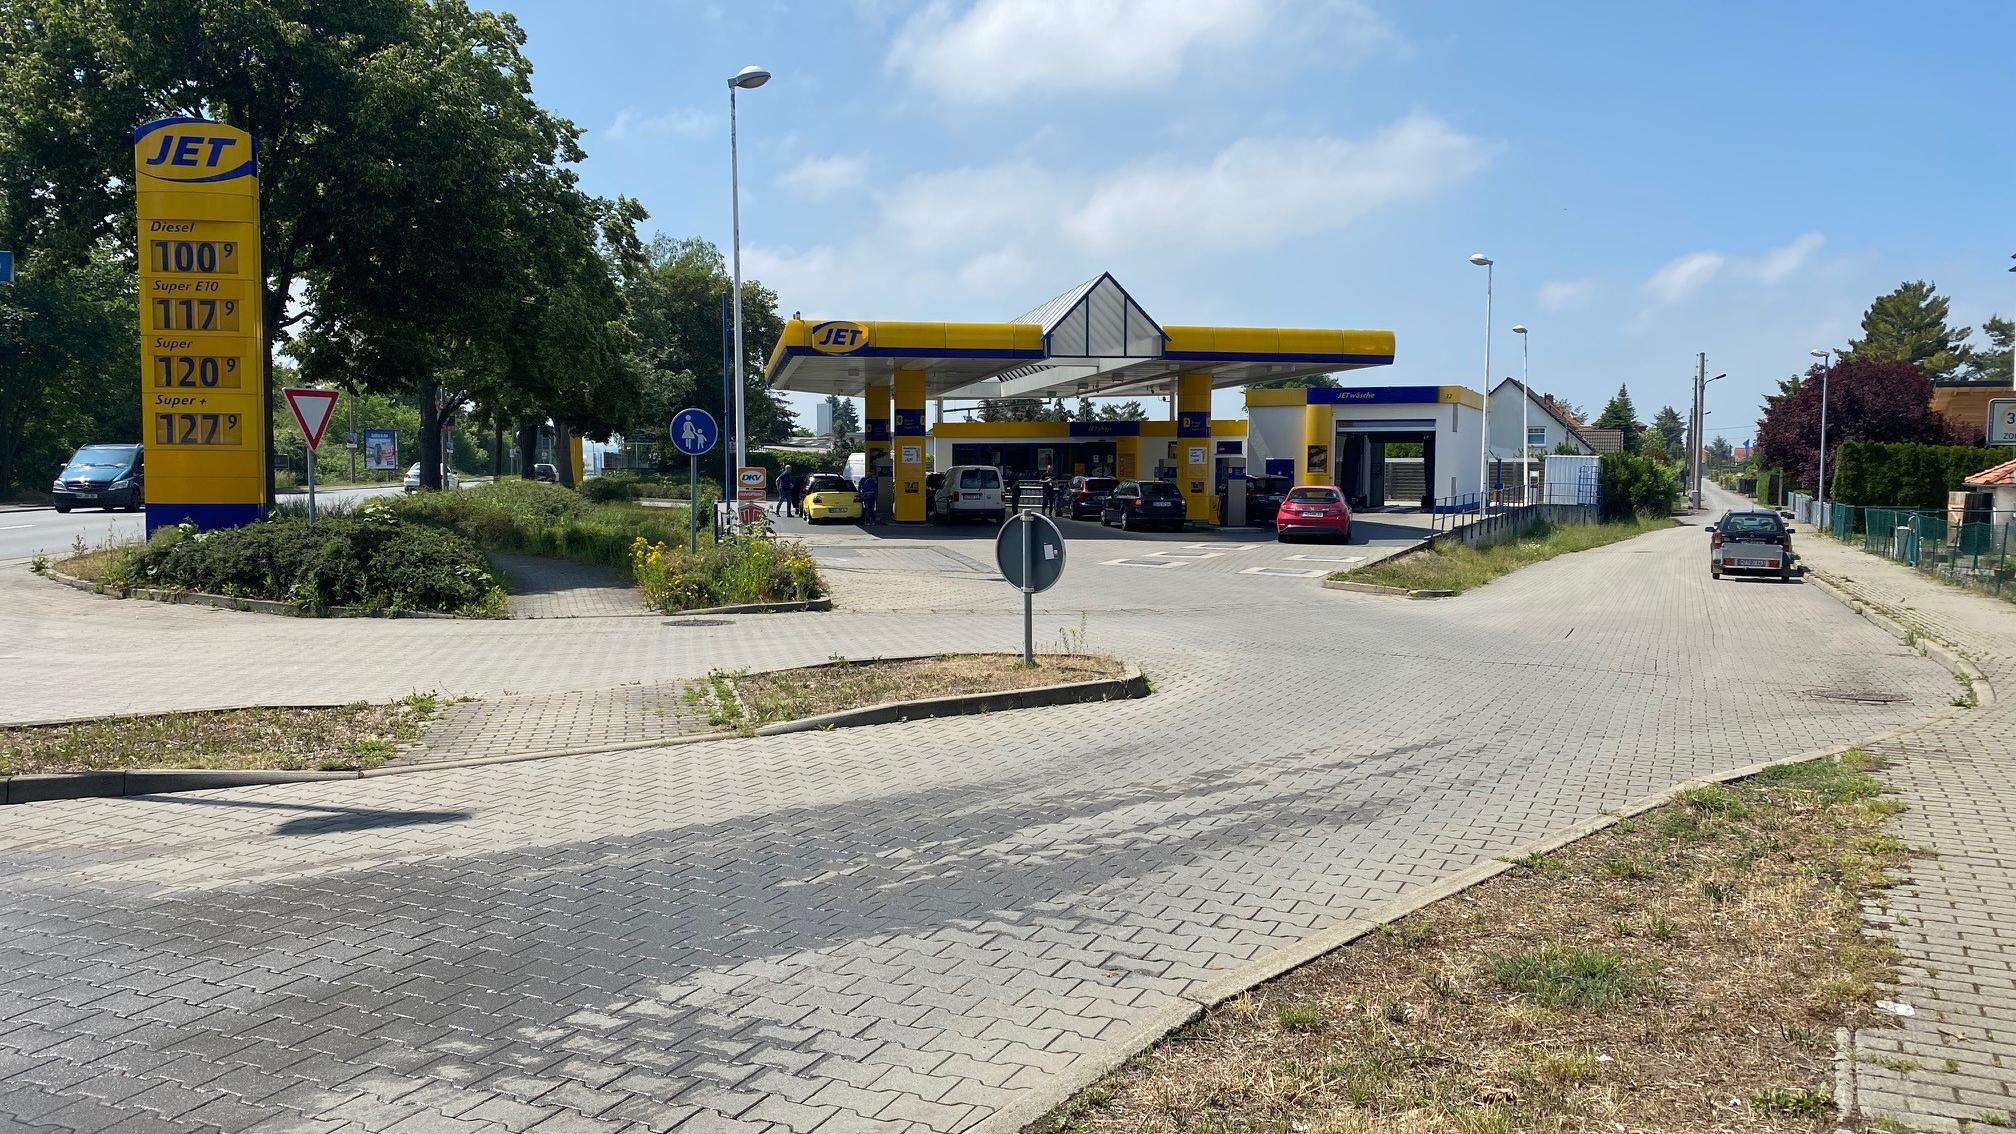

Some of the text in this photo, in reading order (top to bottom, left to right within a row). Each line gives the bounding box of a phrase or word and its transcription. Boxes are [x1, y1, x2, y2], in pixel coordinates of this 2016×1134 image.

[146, 136, 237, 166] JET
[150, 221, 195, 233] Diesel
[153, 280, 219, 293] Super E10
[819, 328, 863, 345] JET
[155, 338, 193, 351] Super
[155, 395, 196, 408] Super
